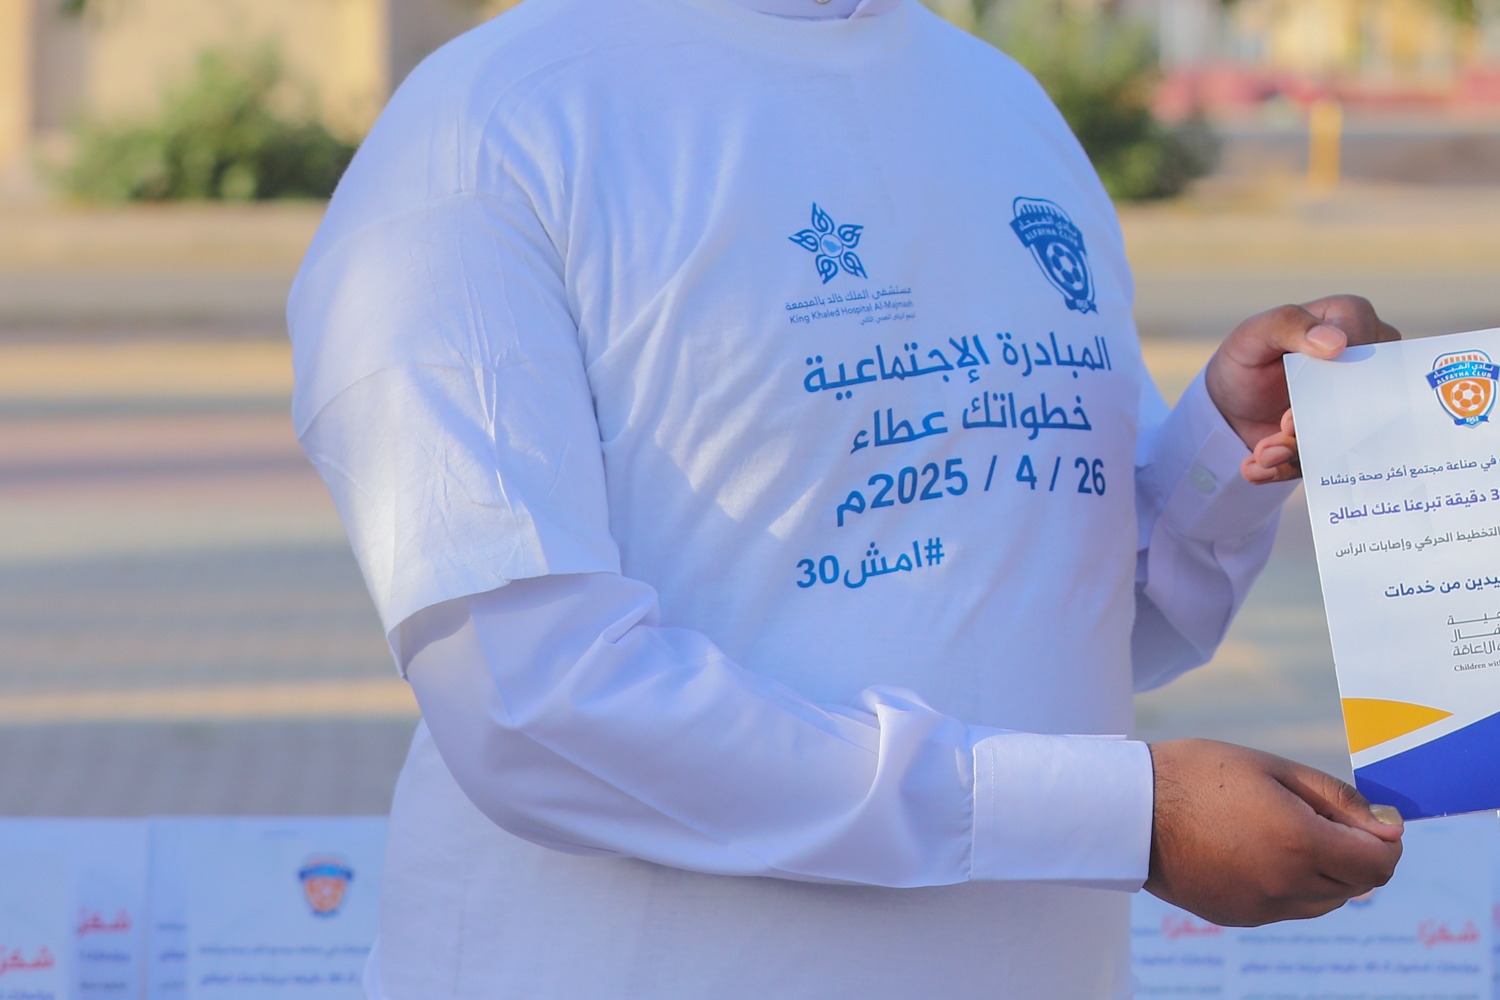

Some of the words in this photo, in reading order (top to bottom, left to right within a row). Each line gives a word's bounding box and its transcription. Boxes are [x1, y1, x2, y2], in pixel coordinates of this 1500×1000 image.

[785, 296, 825, 311] بالمجمعة
[827, 292, 843, 304] خالد
[846, 289, 869, 302] الملك
[790, 315, 810, 324] King
[812, 309, 840, 320] Khaled
[841, 303, 872, 316] Hospital
[996, 331, 1112, 380] المبادرة
[803, 334, 991, 401] الإجتماعية
[1436, 370, 1470, 385] ALFAYHA
[1472, 370, 1493, 378] CLUB
[962, 390, 1092, 441] خطواتك
[850, 408, 949, 456] عطاء
[1409, 465, 1444, 478] مجتمع
[1446, 459, 1478, 471] صناعة
[1480, 454, 1497, 472] في
[1015, 454, 1038, 491] 4
[1074, 457, 1106, 496] 26
[1320, 472, 1357, 487] ونشاط
[1358, 471, 1383, 482] صحة
[1385, 464, 1407, 481] أكثر
[1404, 496, 1442, 513] تبرعنا
[1445, 489, 1487, 508] دقيقة
[1329, 504, 1368, 525] لصالح
[1371, 502, 1401, 516] عنك
[1414, 532, 1454, 552] الحركي
[1456, 525, 1500, 543] التخطيط
[1335, 542, 1367, 558] الرأس
[1368, 538, 1412, 553] وإصابات
[1384, 579, 1436, 598] خدمات
[1439, 580, 1461, 595] من
[1453, 657, 1486, 672] Children
